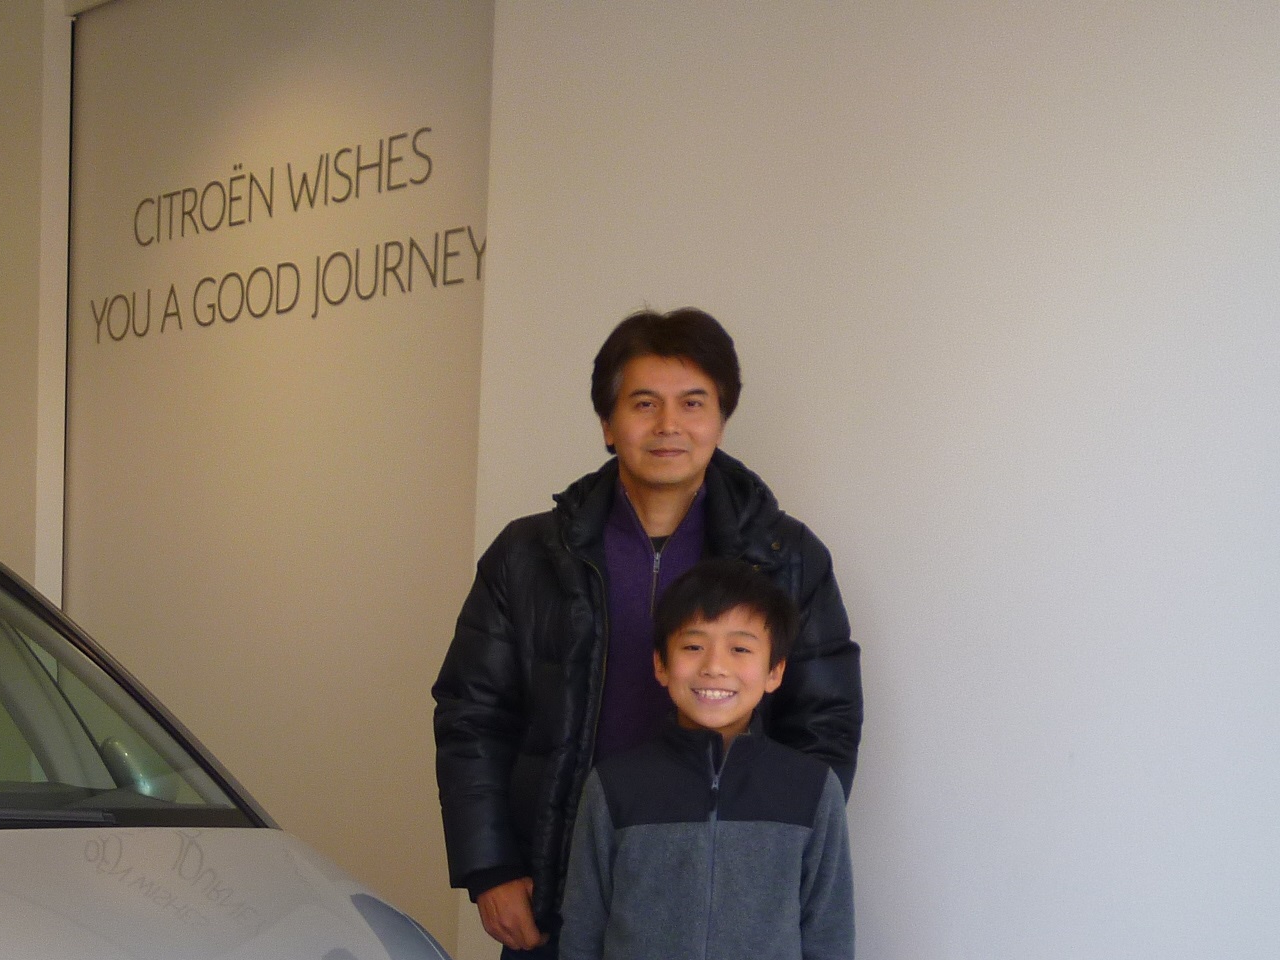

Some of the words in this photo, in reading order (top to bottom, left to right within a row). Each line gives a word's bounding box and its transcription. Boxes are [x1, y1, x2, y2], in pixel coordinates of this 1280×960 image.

[133, 163, 275, 247] CITROËN
[286, 127, 433, 213] WISHES
[90, 288, 152, 344] YOU
[160, 283, 183, 334] A
[192, 261, 301, 328] GOOD
[310, 225, 487, 319] JOURNEY
